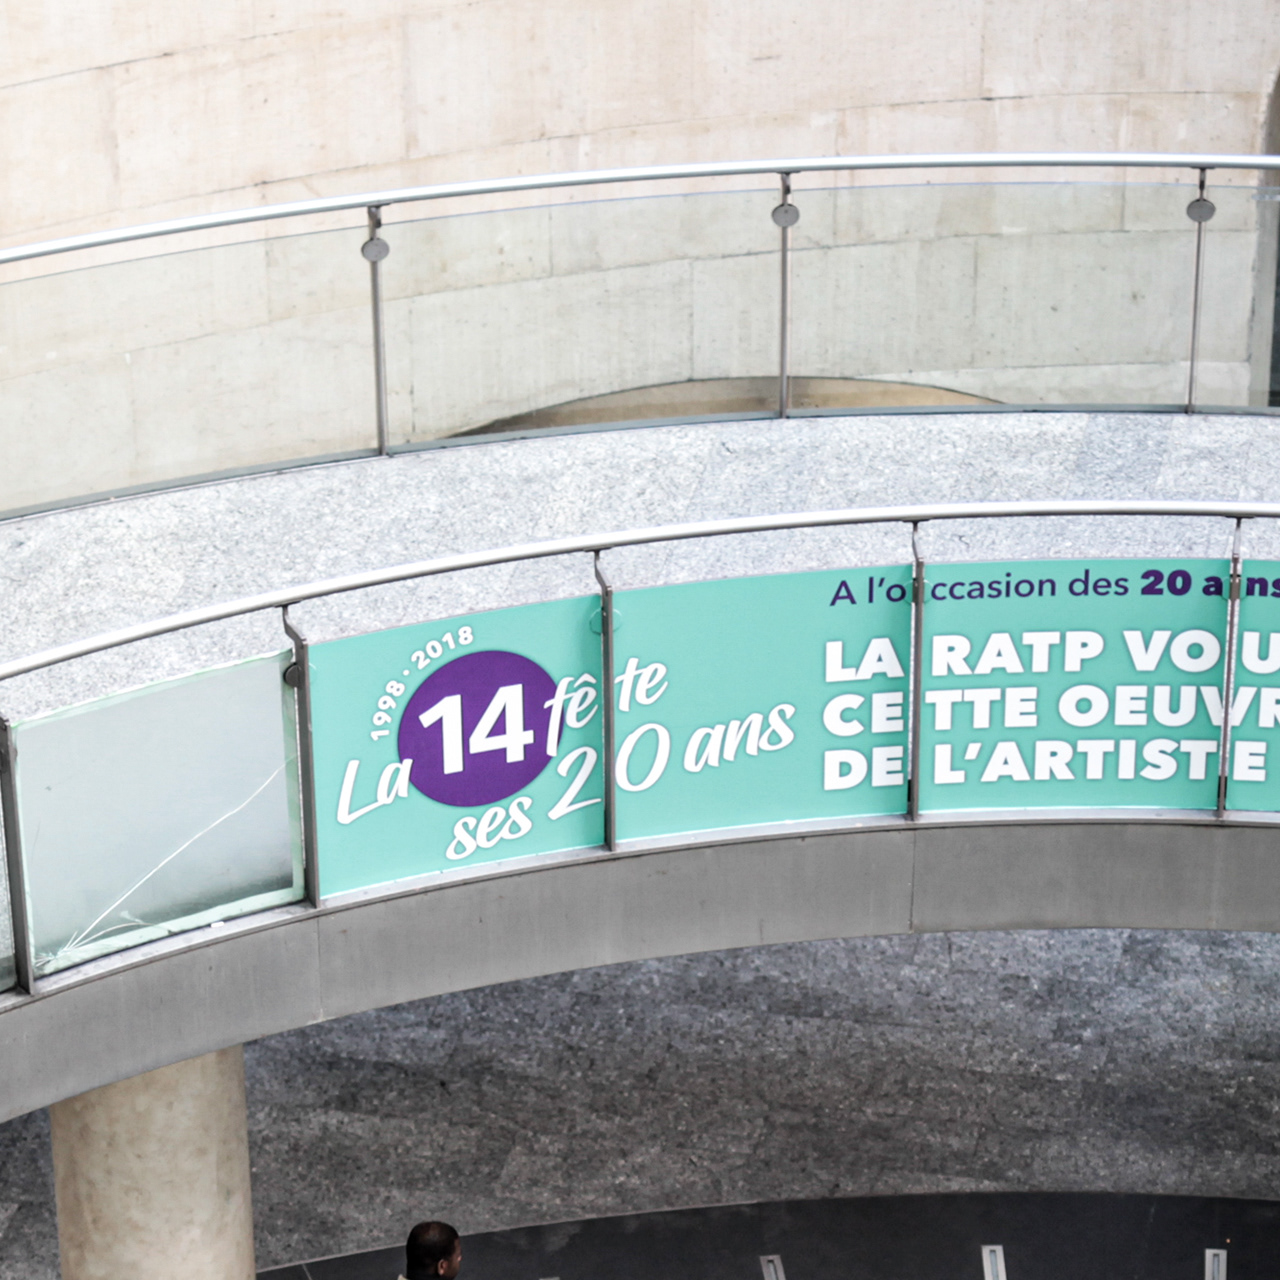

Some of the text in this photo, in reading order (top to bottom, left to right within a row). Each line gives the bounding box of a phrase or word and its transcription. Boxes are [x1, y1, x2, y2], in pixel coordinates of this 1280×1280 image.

[830, 580, 857, 606] A
[1068, 569, 1129, 597] des
[1140, 569, 1192, 596] 20
[370, 625, 474, 741] 1998 2018
[825, 637, 905, 683] LA
[931, 631, 1105, 677] RATP
[822, 686, 1038, 737] CETTE
[336, 657, 669, 825] La 14 fête
[445, 703, 796, 861] ses 20 ans
[823, 745, 904, 791] DE
